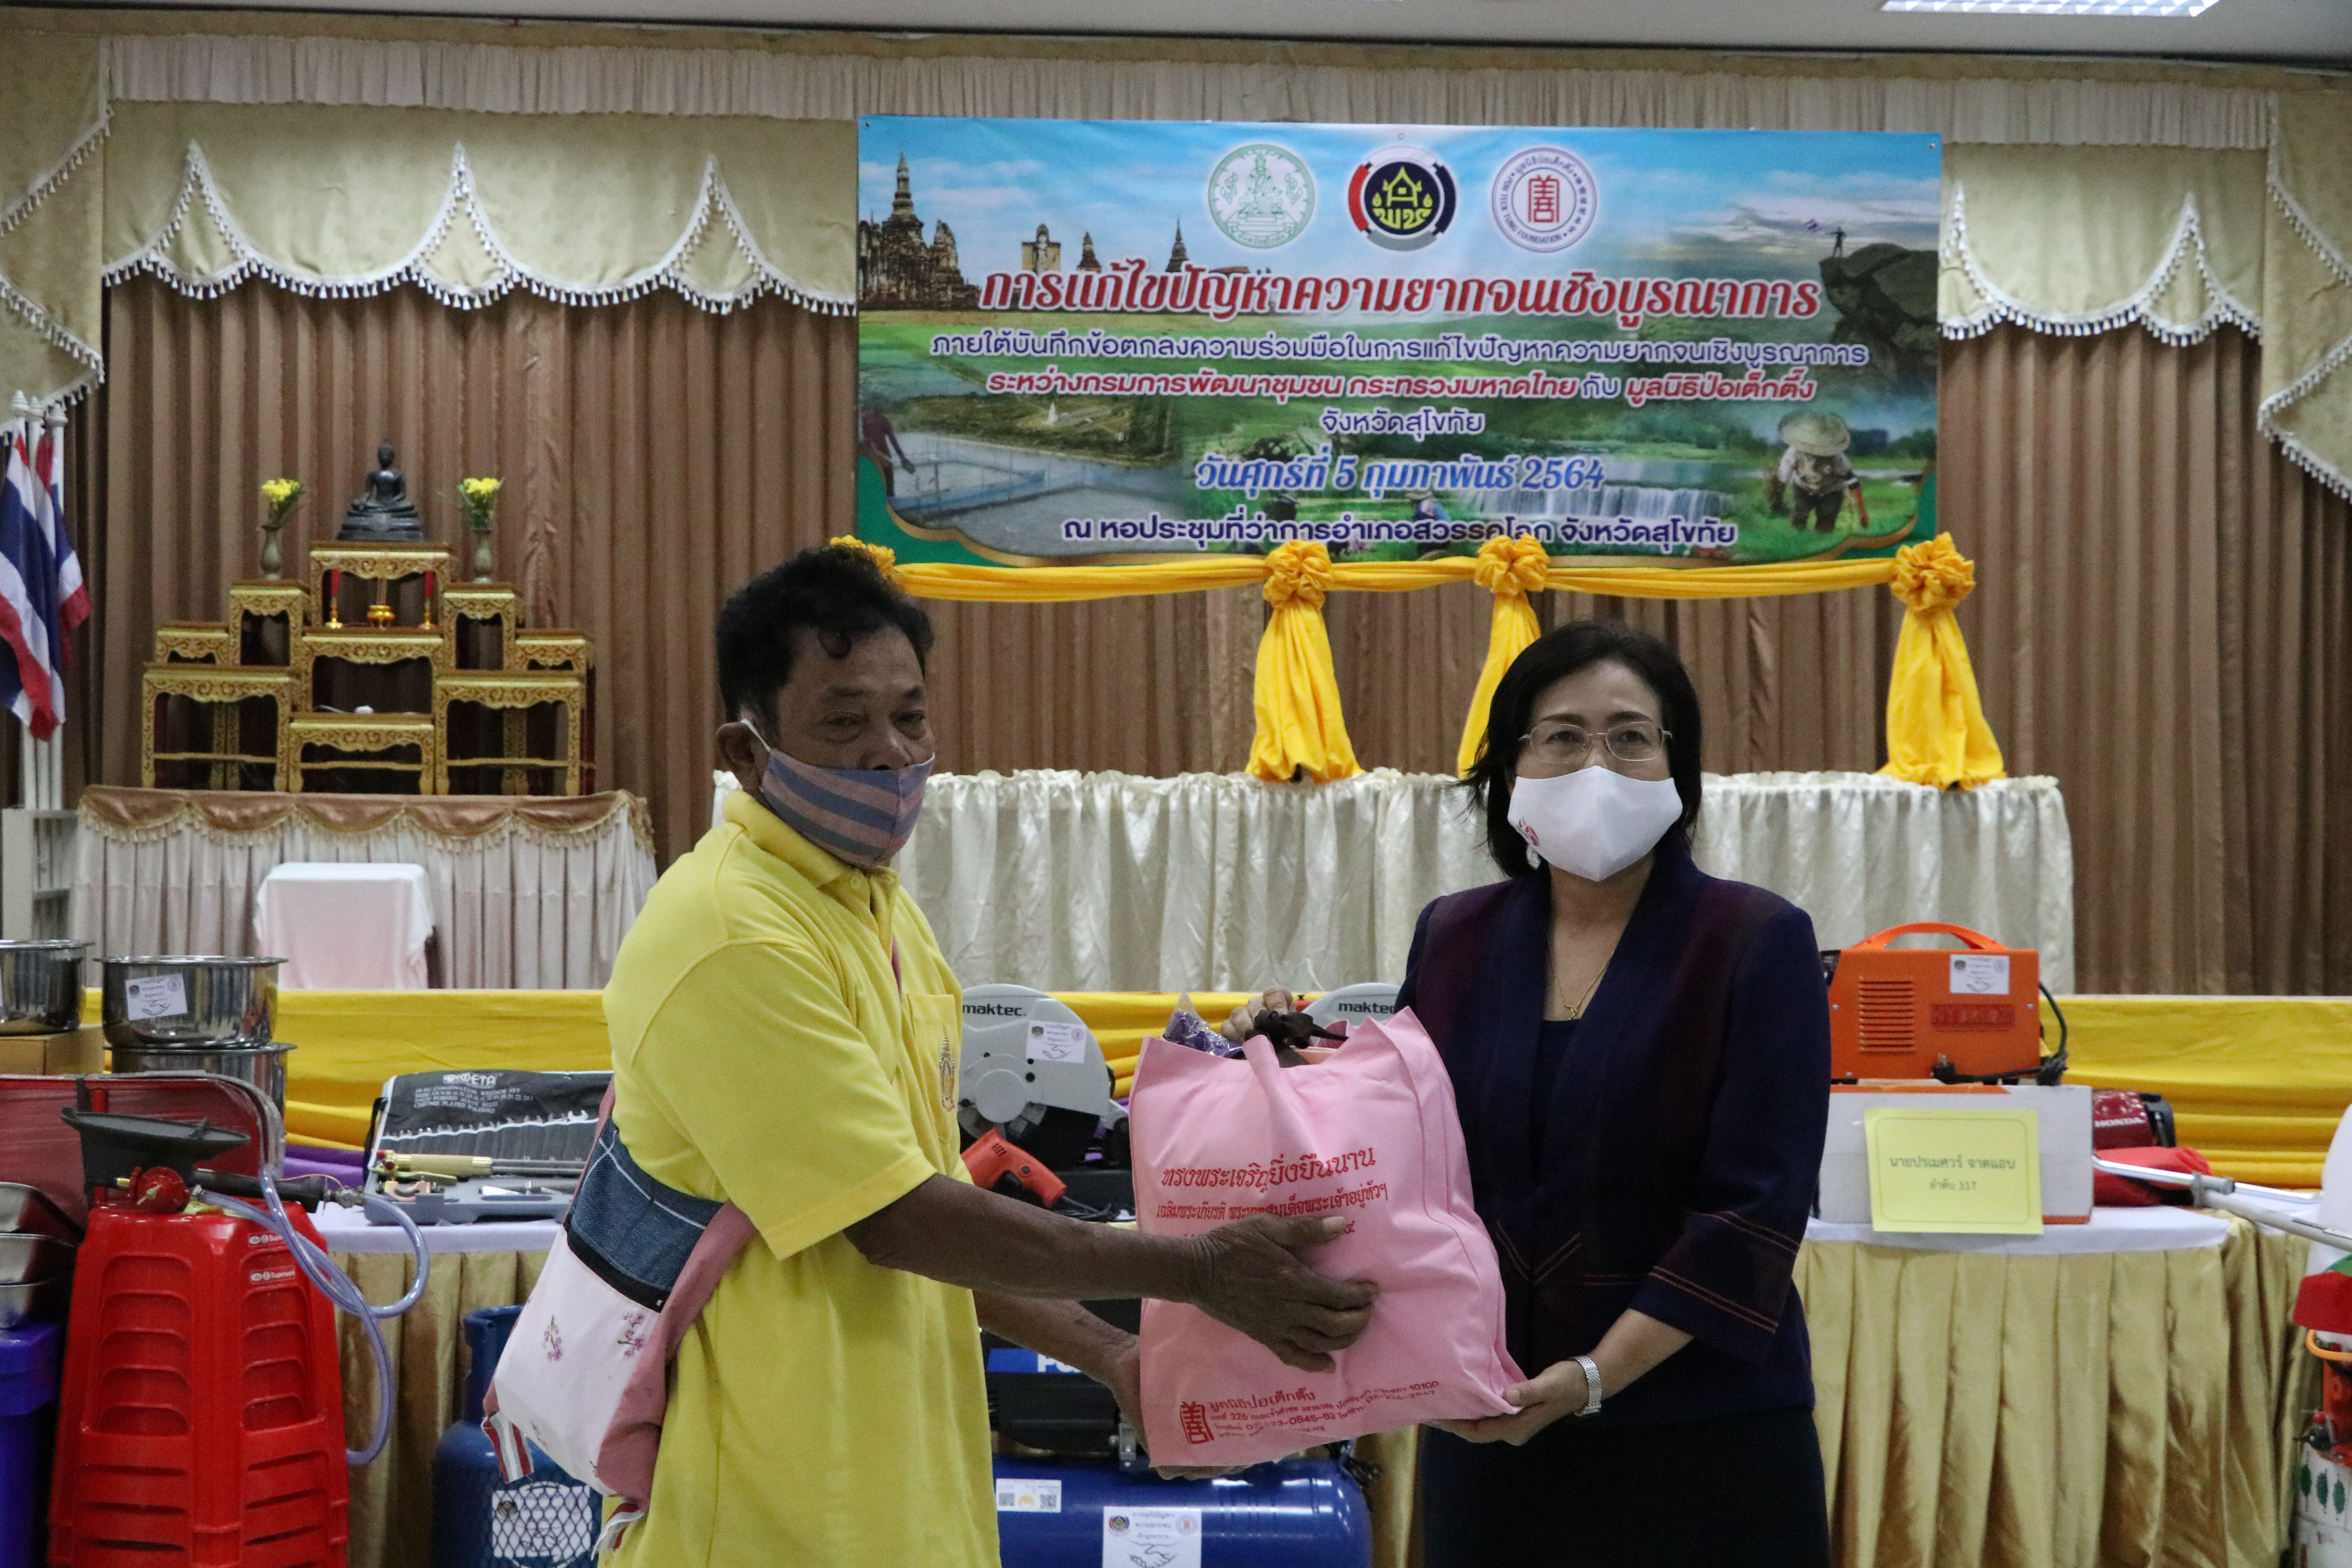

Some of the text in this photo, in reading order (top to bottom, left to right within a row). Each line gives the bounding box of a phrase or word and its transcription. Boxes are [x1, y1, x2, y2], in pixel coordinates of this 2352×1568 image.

[982, 258, 1819, 328] การแก้ไขปัญหาความยากจนเชิงบูรณาการ
[933, 330, 1869, 367] ภายใต้บันทึกข้อตกลงความร่วมมือในการแก้ไขปัญหาความยากจนเชิงบูรณาการ
[989, 368, 1813, 404] ระหว่างกรมการพัฒนาชุมชน กระทรวงมหาดไทย กับ มูลนิธิป่อเต็กตึ๊ง
[1323, 409, 1483, 438] จังหวัดสุโขทัย
[1198, 445, 1604, 497] วันศุกร์ที่ 5 กุมภาพันธ์ 2564
[1065, 519, 1091, 539] ณ
[1562, 517, 1735, 551] จังหวัดสุโขทัย
[963, 1003, 1023, 1016] maktec
[2094, 1117, 2147, 1127] HONDA
[1161, 1148, 1376, 1193] ทรงพระเจริญยิ่งยืนนาน
[1157, 1201, 1226, 1220] เฉลิมพระเกียรติ
[1409, 1380, 1439, 1390] 10100
